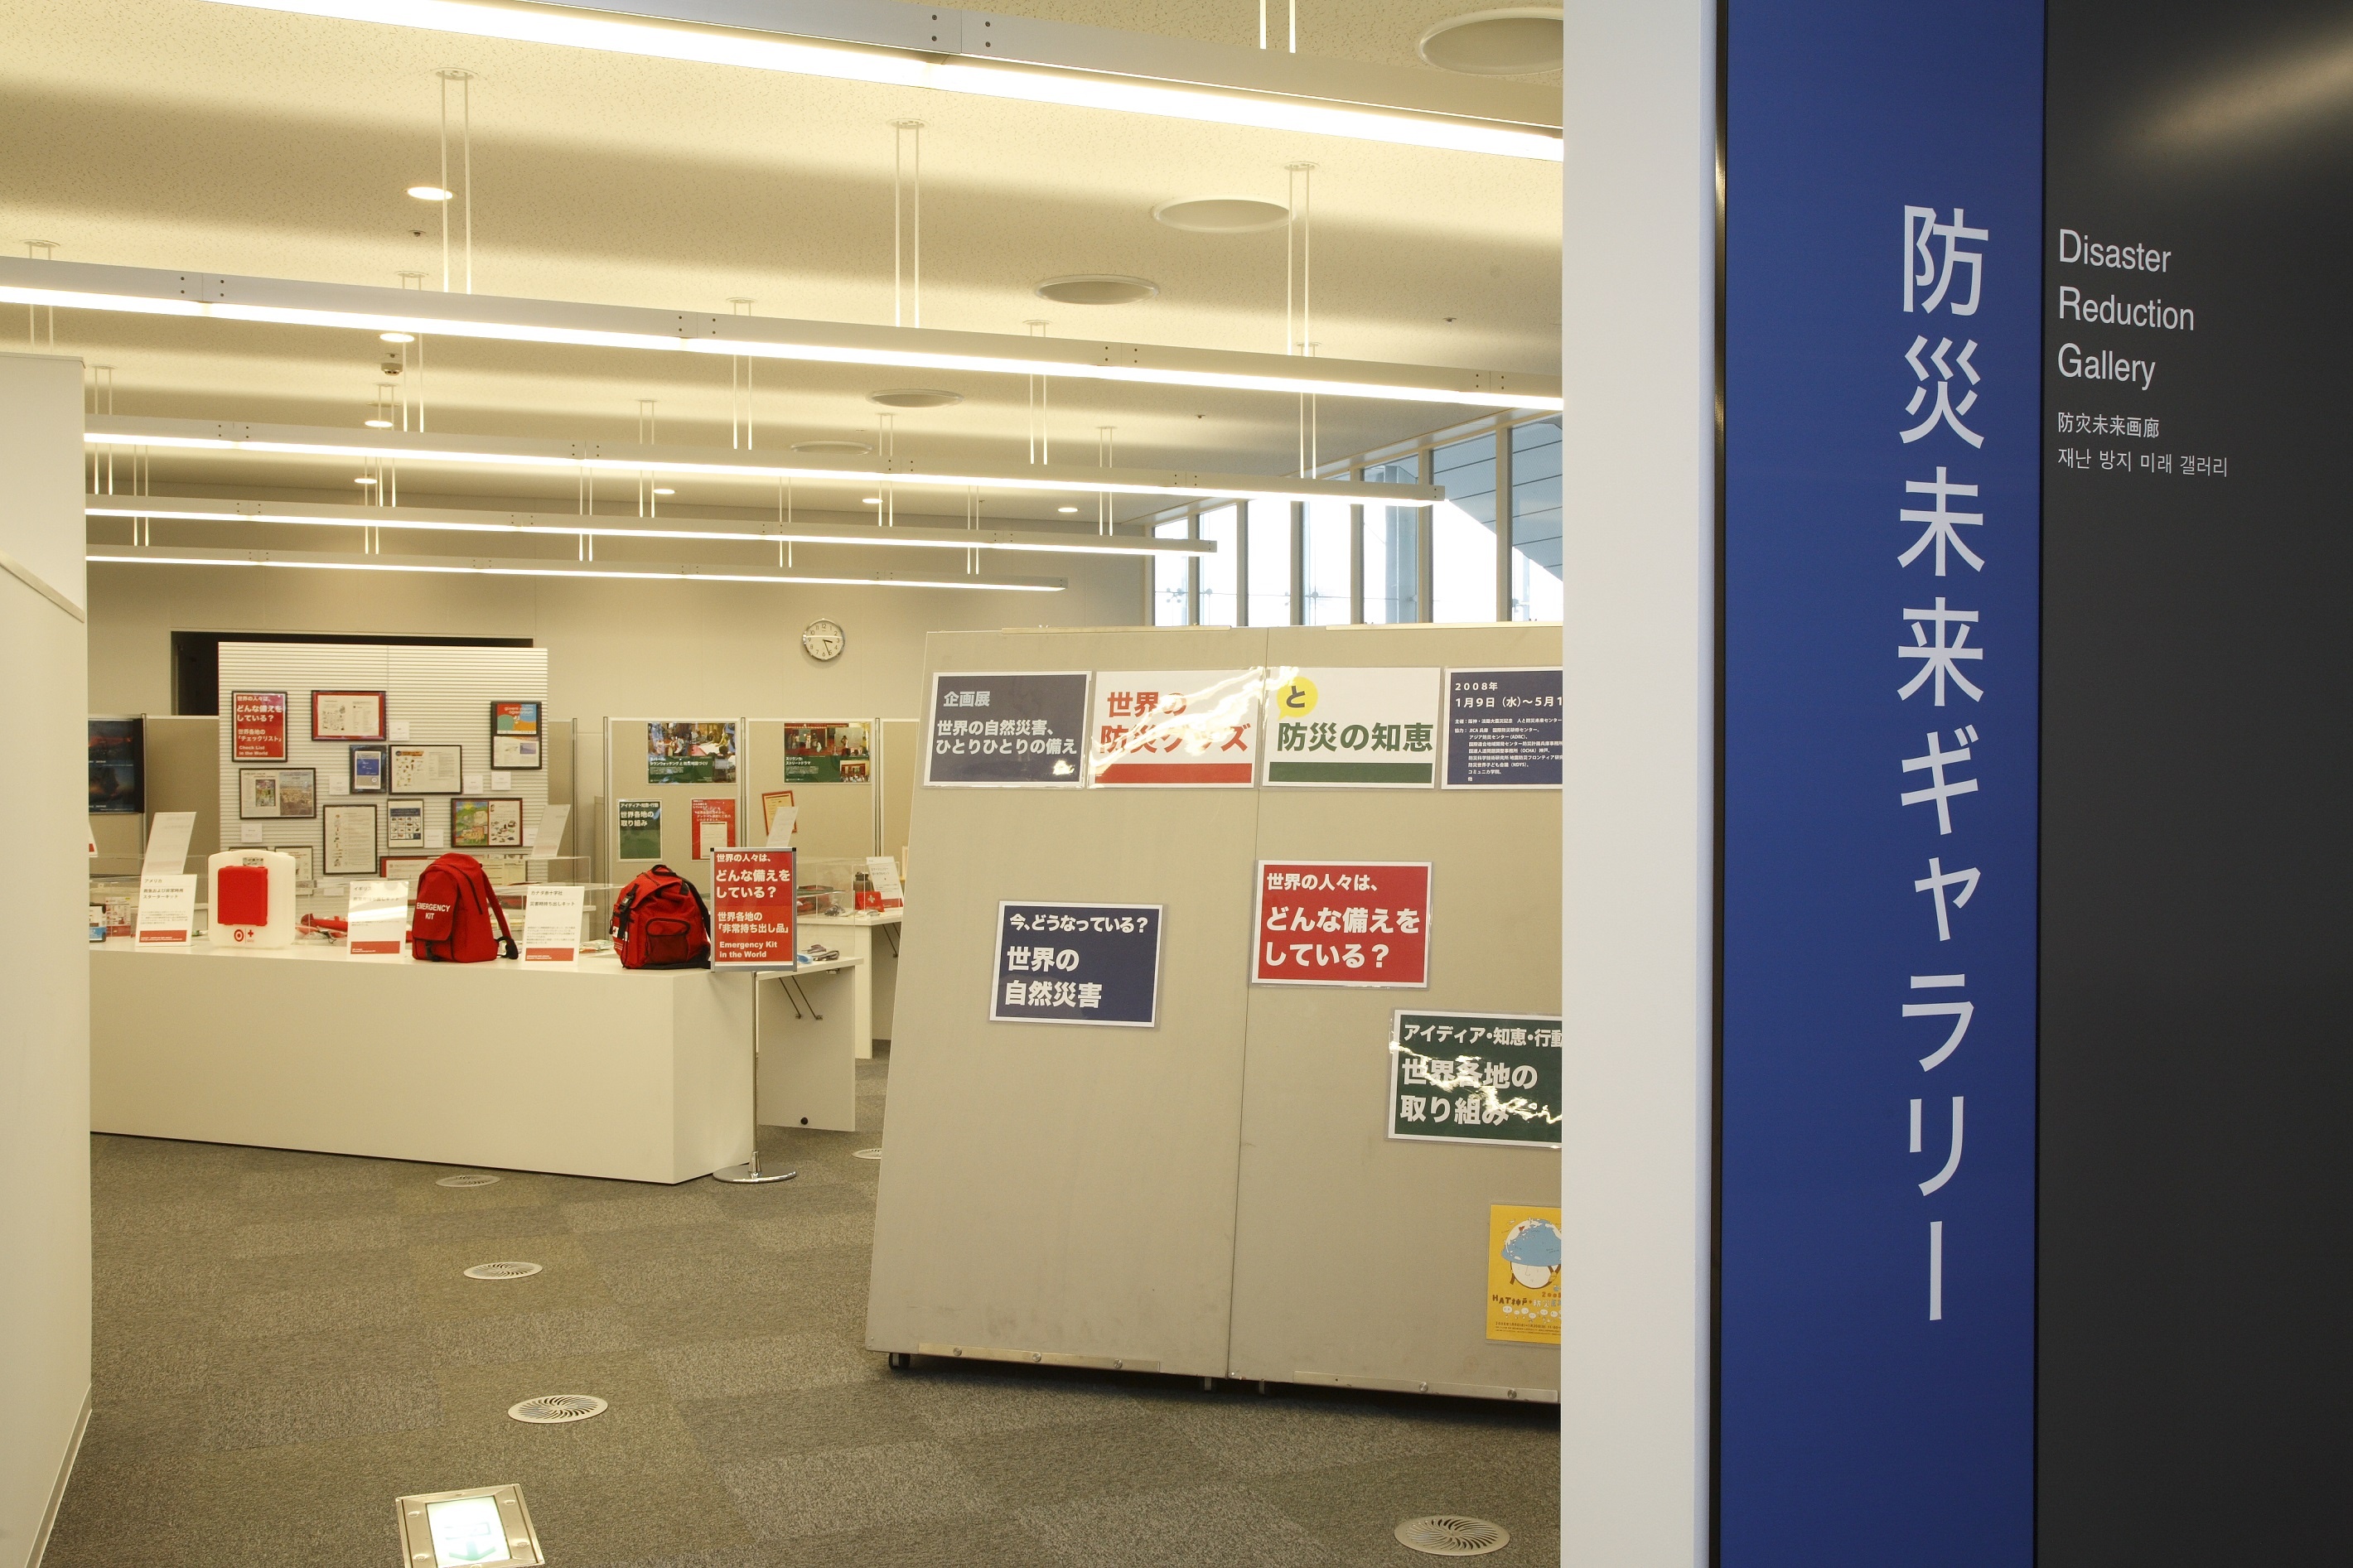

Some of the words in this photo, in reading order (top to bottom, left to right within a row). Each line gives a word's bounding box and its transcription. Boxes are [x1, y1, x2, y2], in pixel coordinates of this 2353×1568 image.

[2060, 229, 2172, 273] Disaster
[2060, 286, 2195, 330] Reduction
[2058, 343, 2156, 391] Gallery
[2058, 412, 2160, 438] 防灾未来画廊
[2058, 447, 2091, 470] 재난
[2099, 450, 2132, 472] 방지
[2141, 452, 2172, 474] 미래
[2180, 456, 2228, 477] 갤러리
[1286, 685, 1306, 708] と
[1455, 682, 1498, 691] 2008年
[943, 691, 990, 707] 企画展
[937, 720, 1054, 736] 世界の自然災害、
[1277, 722, 1434, 752] 防災の知恵
[935, 738, 1077, 755] ひとりひとりの備え
[1897, 205, 1988, 1321] 防災未来ギャラリー
[717, 853, 771, 862] 世界の人々は、
[716, 869, 790, 882] どんな備えを
[1267, 872, 1378, 891] 世界の人々は、
[716, 886, 776, 899] している？
[416, 902, 451, 912] EMERGENCY
[717, 912, 762, 922] 世界各地の
[1009, 913, 1148, 934] 今、どうなっている？
[1267, 906, 1420, 934] どんな備えを
[719, 941, 764, 949] Emergency
[1266, 941, 1389, 968] している？
[1007, 946, 1080, 972] 世界の
[1005, 980, 1103, 1008] 自然災害
[1402, 1058, 1538, 1090] 世界各地の
[1400, 1094, 1510, 1126] 取り組み
